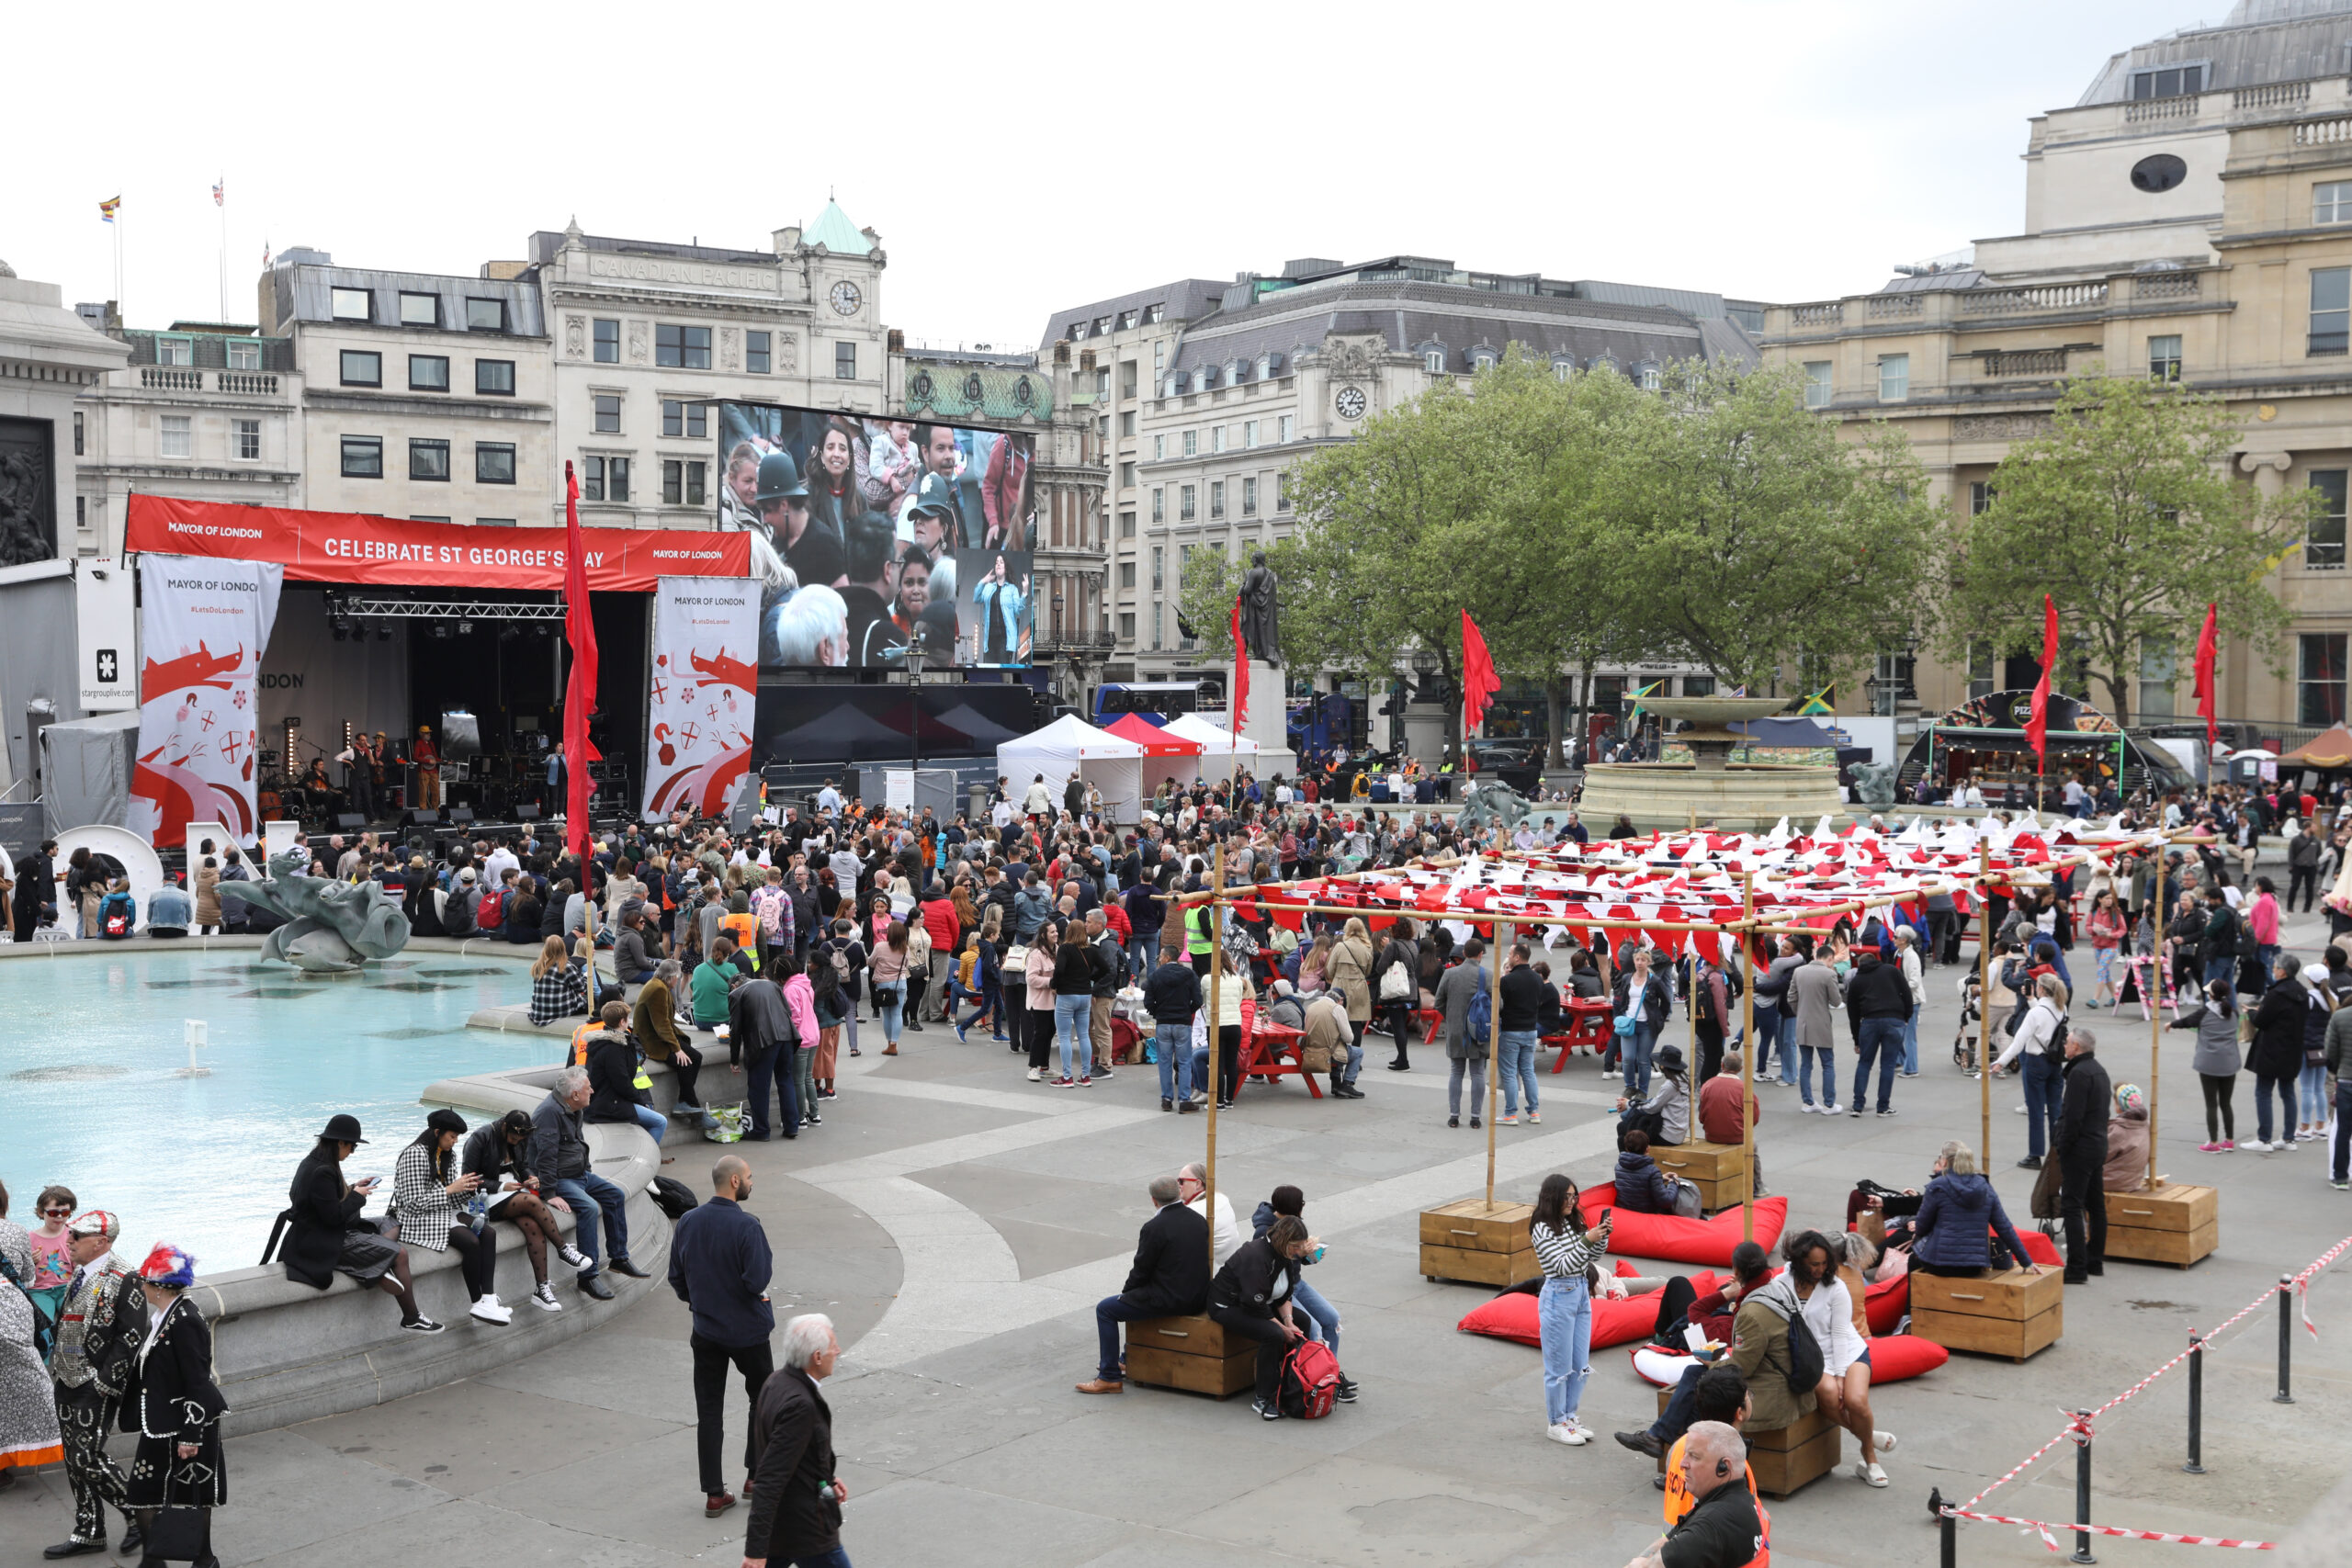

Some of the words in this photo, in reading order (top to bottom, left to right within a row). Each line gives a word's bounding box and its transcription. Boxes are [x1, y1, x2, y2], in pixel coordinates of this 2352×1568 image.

[594, 259, 692, 283] CANADIAN
[703, 267, 773, 289] PACIFIC
[168, 522, 203, 535] MAYOR
[205, 525, 218, 536] OF
[220, 527, 262, 539] LONDON
[324, 537, 435, 562] CELEBRATE
[439, 546, 462, 563] ST
[469, 547, 565, 567] GEORGE'S
[584, 551, 605, 568] AY
[653, 549, 678, 558] MAYOR
[680, 550, 690, 558] OF
[691, 551, 722, 559] LONDON
[167, 579, 203, 590] MAYOR
[205, 581, 219, 591] OF
[674, 596, 701, 605] MAYOR
[703, 597, 713, 605] OF
[715, 597, 745, 606] LONDON
[190, 605, 243, 615] #LetsDoLondon
[258, 673, 304, 689] NDON
[81, 688, 135, 699] stargrouplive.com
